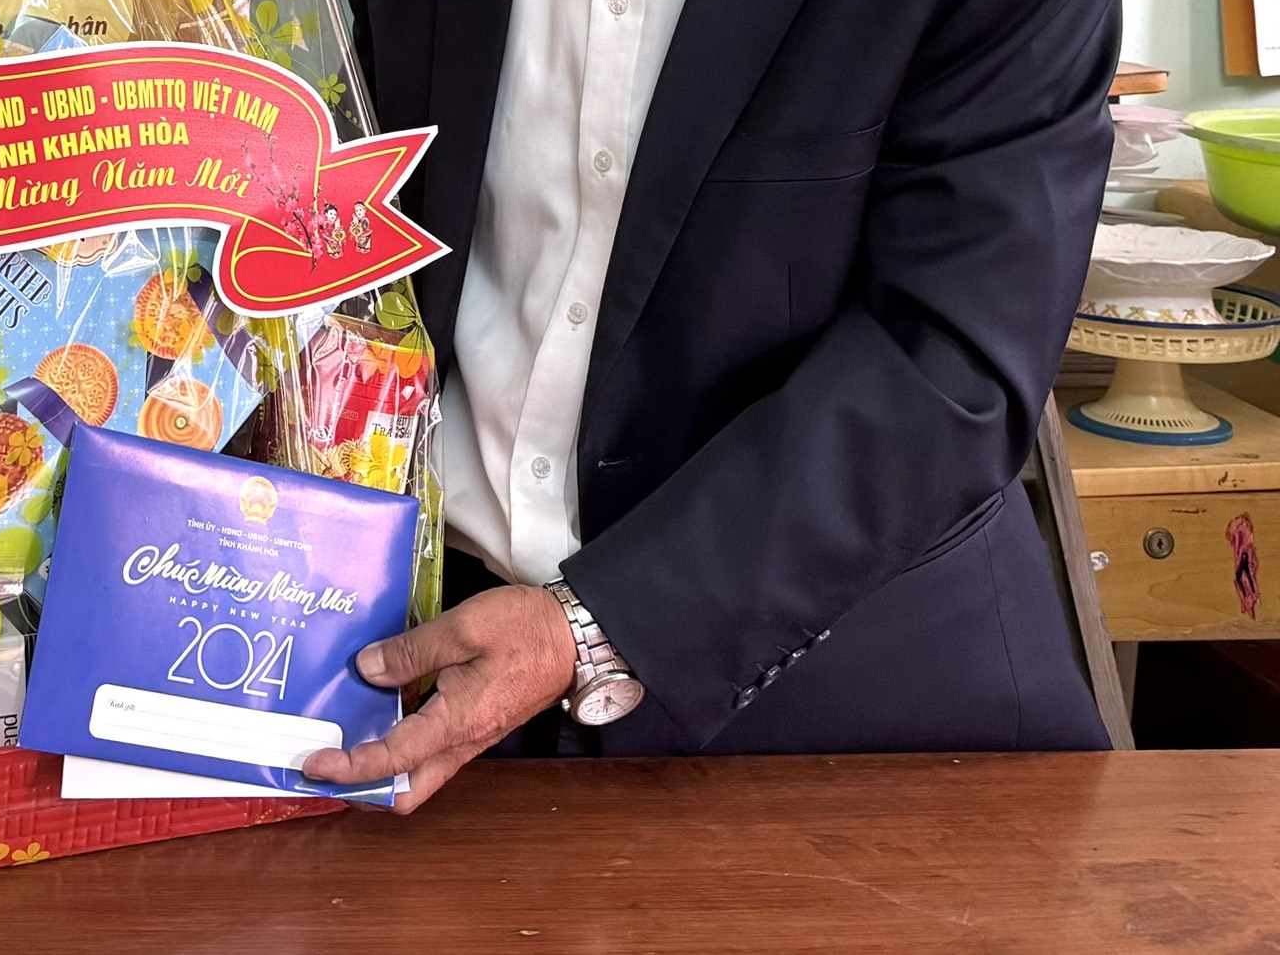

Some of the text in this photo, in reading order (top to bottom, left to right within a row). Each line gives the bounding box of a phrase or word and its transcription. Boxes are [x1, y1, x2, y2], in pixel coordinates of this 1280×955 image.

[63, 16, 108, 36] hân
[42, 85, 95, 122] UBND
[112, 78, 187, 112] UBMTTQ
[192, 77, 231, 119] VIỆT
[234, 91, 280, 134] NAM
[43, 125, 132, 160] KHÁNH
[139, 116, 189, 146] HÒA
[92, 158, 178, 194] Năm
[185, 157, 253, 199] Mới
[187, 518, 205, 530] TỈNH
[205, 519, 216, 532] ỦY
[221, 526, 242, 537] HĐND
[248, 531, 268, 543] UBND
[219, 538, 279, 558] TỈNH KHÁNH HÒA
[122, 543, 359, 616] Chúc Mừng Năm Mới
[169, 596, 307, 629] HAPPY NEW YEAR
[167, 616, 294, 700] 2024
